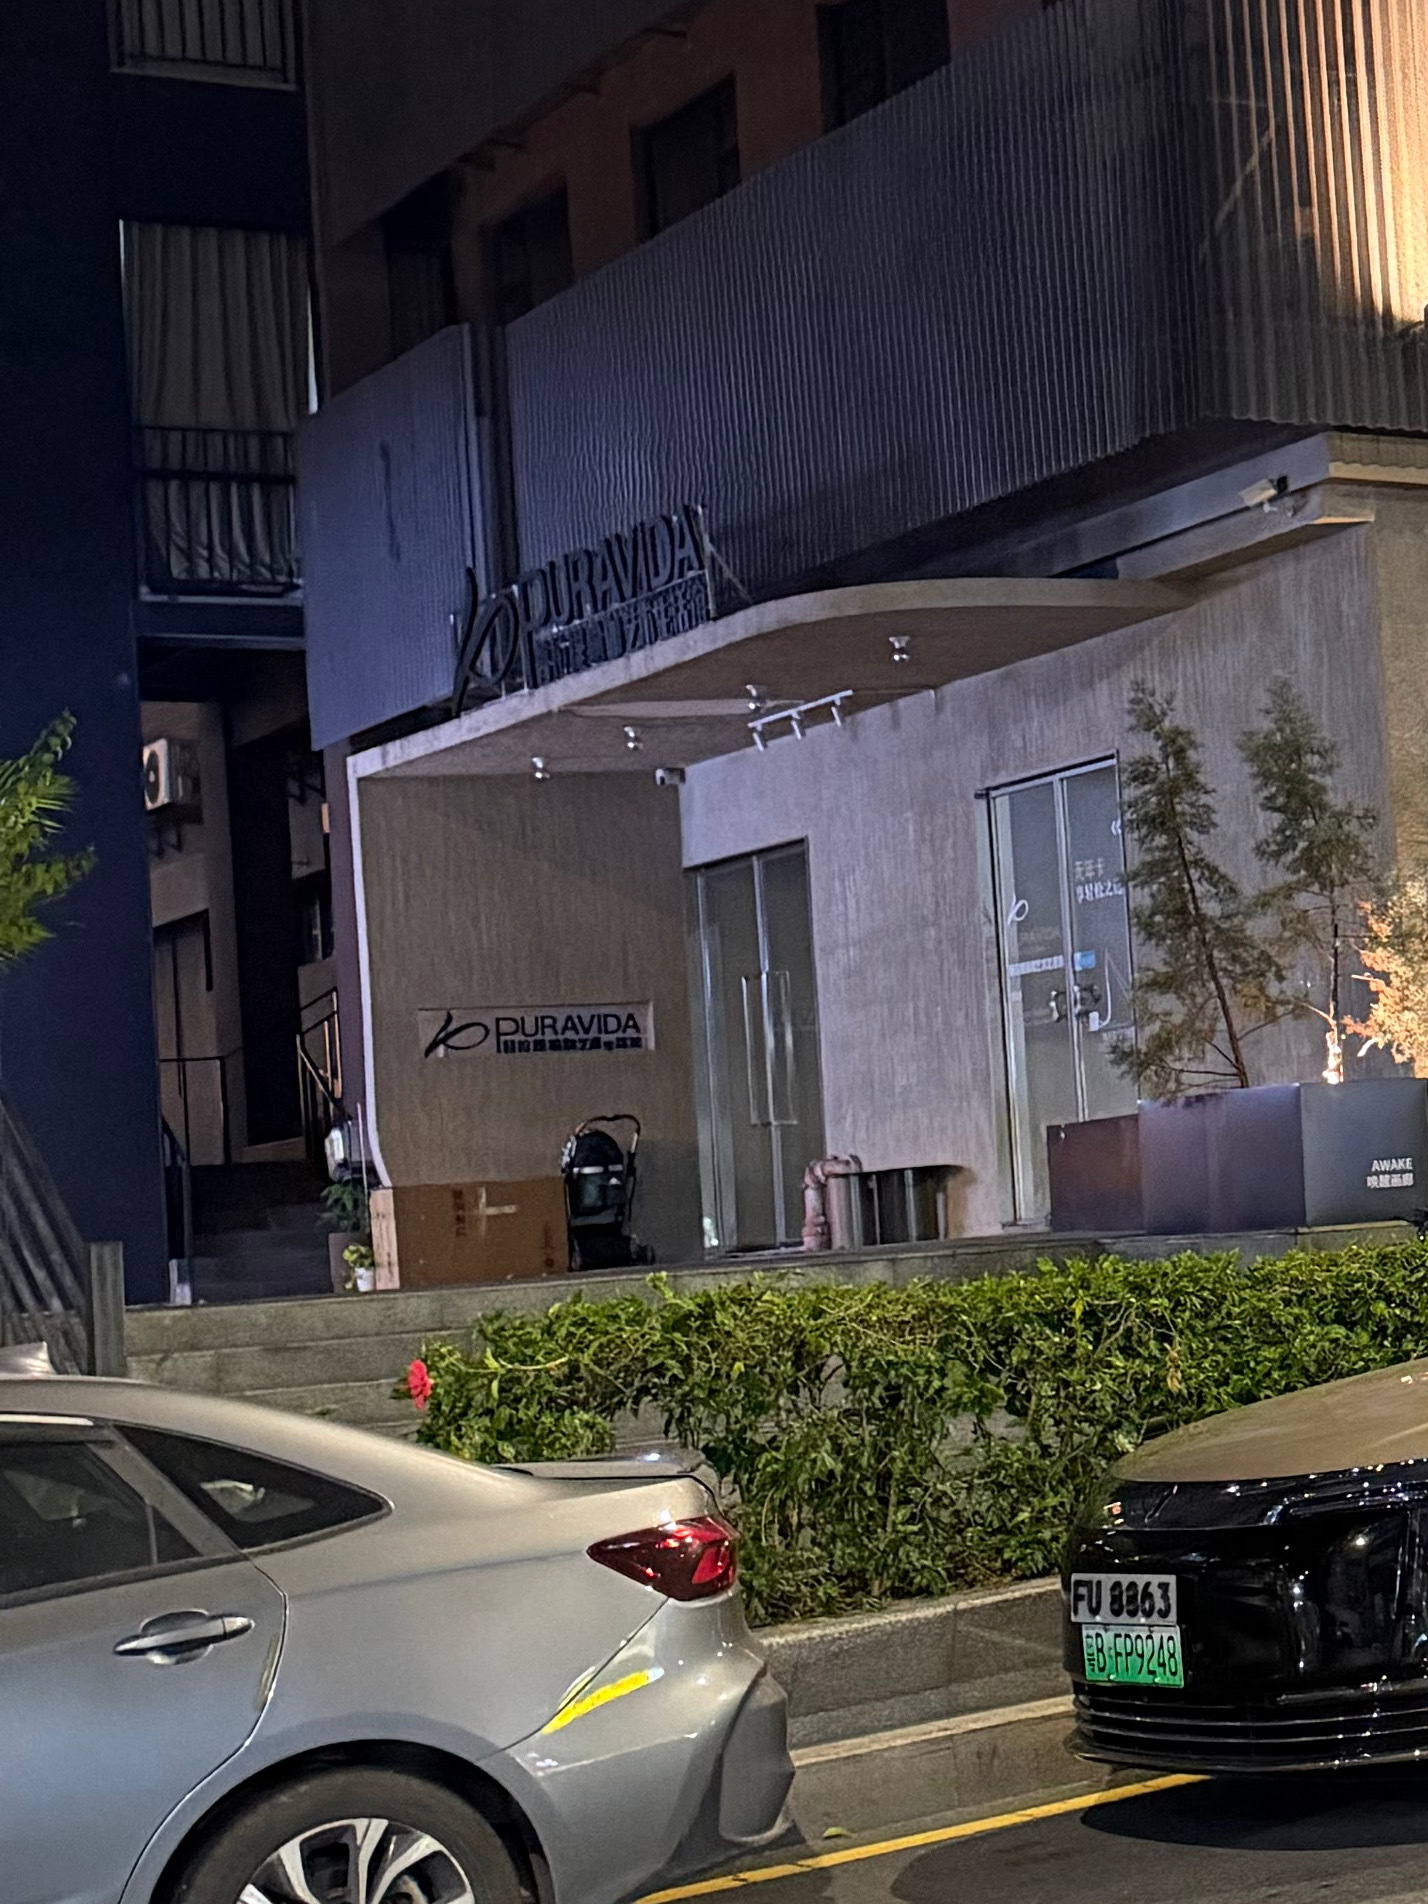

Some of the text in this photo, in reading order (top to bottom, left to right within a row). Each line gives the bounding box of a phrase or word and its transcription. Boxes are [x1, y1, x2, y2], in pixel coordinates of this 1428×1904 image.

[496, 1013, 641, 1053] PURAVIDA
[1371, 1157, 1413, 1172] AWAKE
[1073, 1579, 1171, 1619] FU 8863
